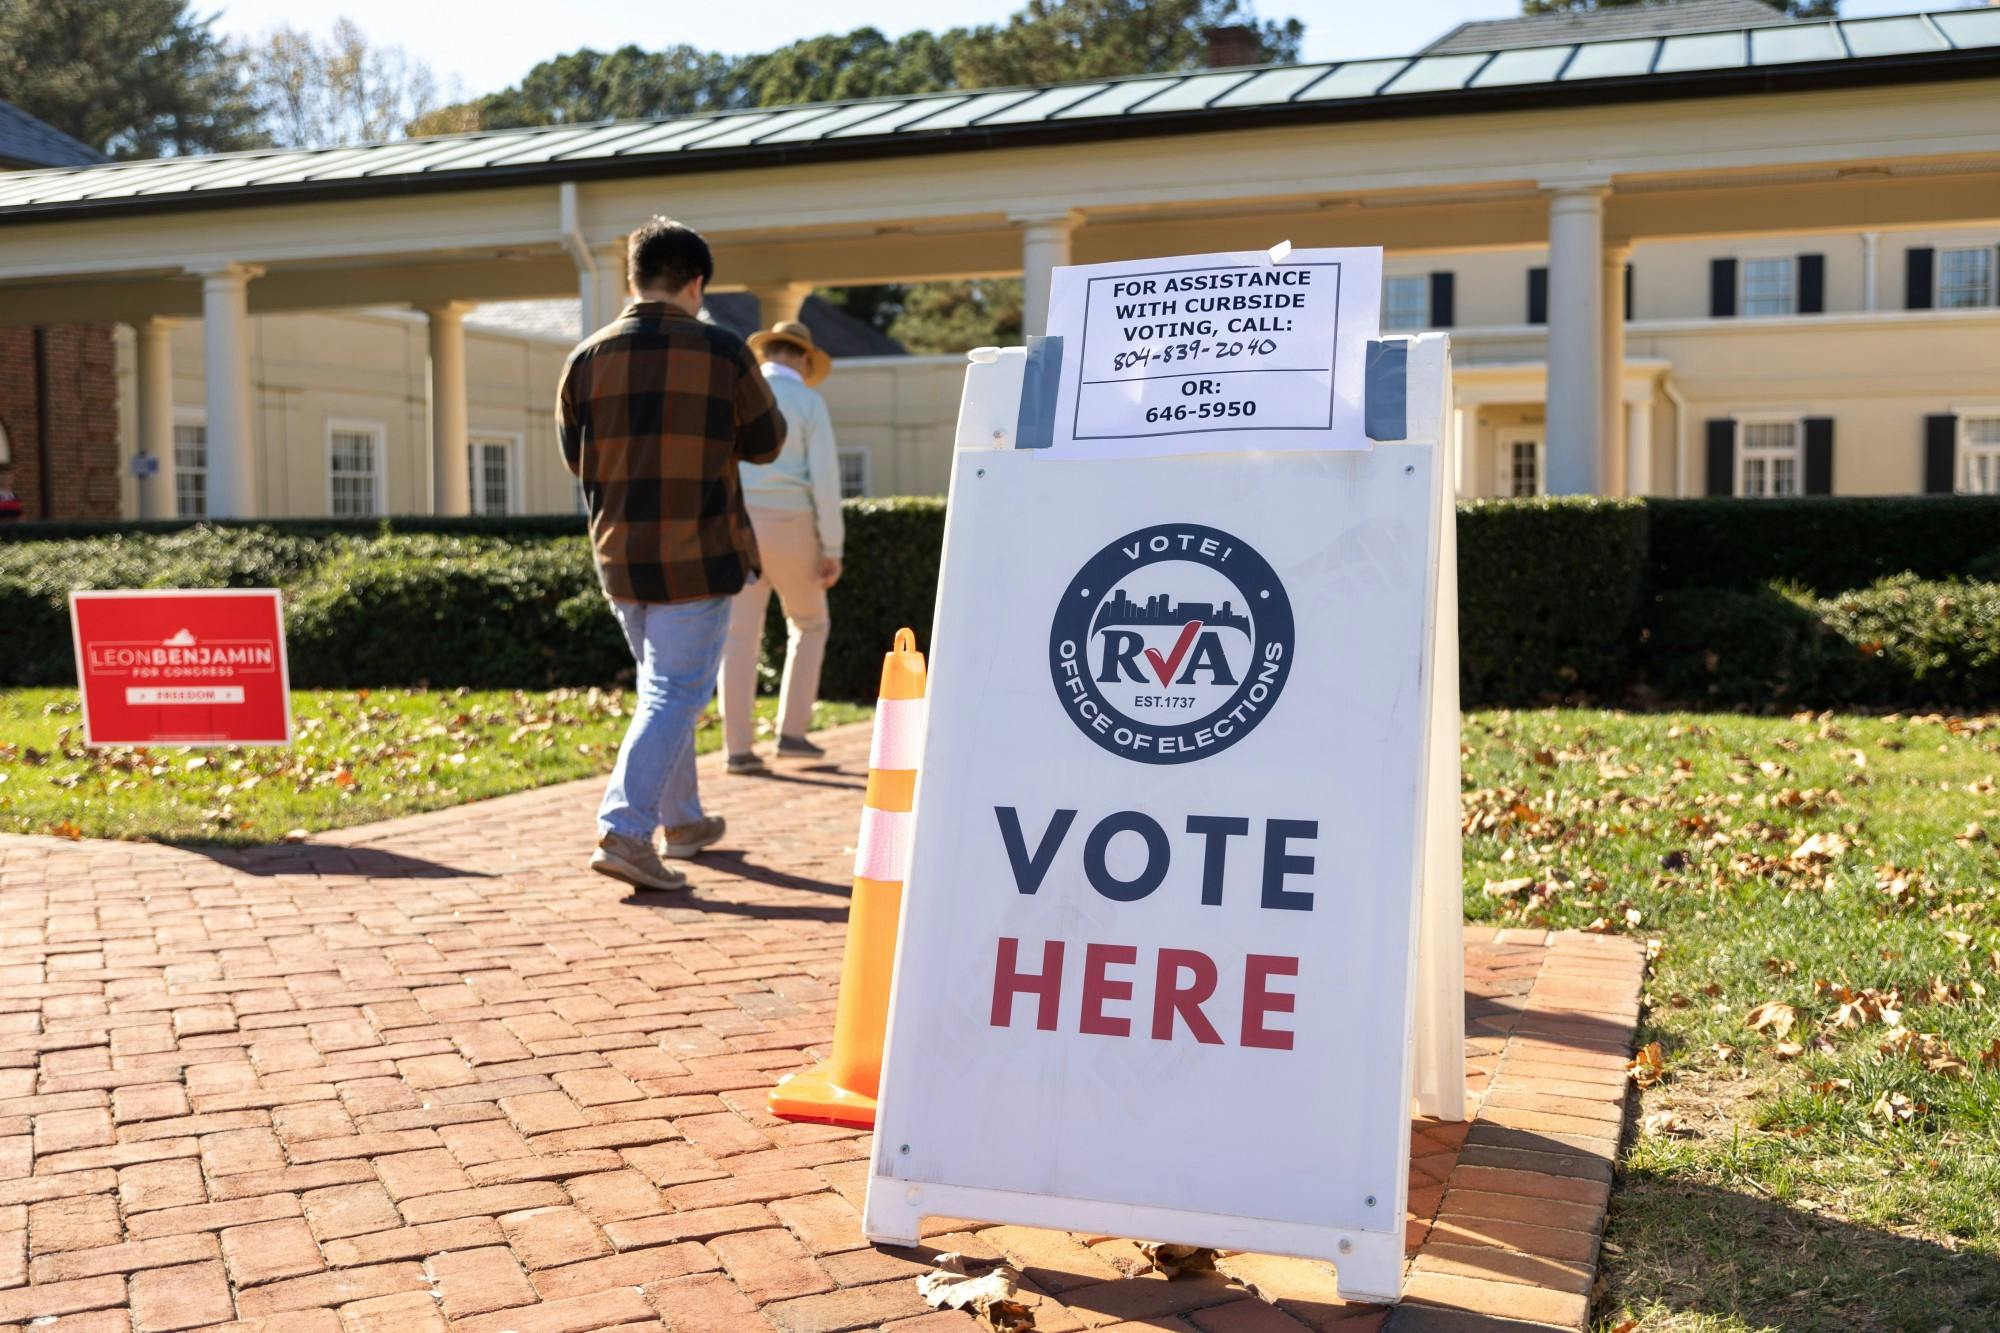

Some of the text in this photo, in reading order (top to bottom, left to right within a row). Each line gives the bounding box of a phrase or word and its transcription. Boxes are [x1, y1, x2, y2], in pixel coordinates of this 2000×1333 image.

[1113, 270, 1311, 298] FOR ASSISTANCE
[1116, 293, 1306, 320] WITH CURBSIDE
[1124, 317, 1293, 342] VOTING, CALL:
[1181, 380, 1221, 396] OR:
[1145, 400, 1257, 423] 646-5950
[1122, 534, 1232, 562] VOTE!
[132, 667, 159, 678] FOR
[1059, 640, 1283, 754] OFFICE OF ELECTIONS
[993, 806, 1319, 912] VOTE
[990, 936, 1299, 1051] HERE
